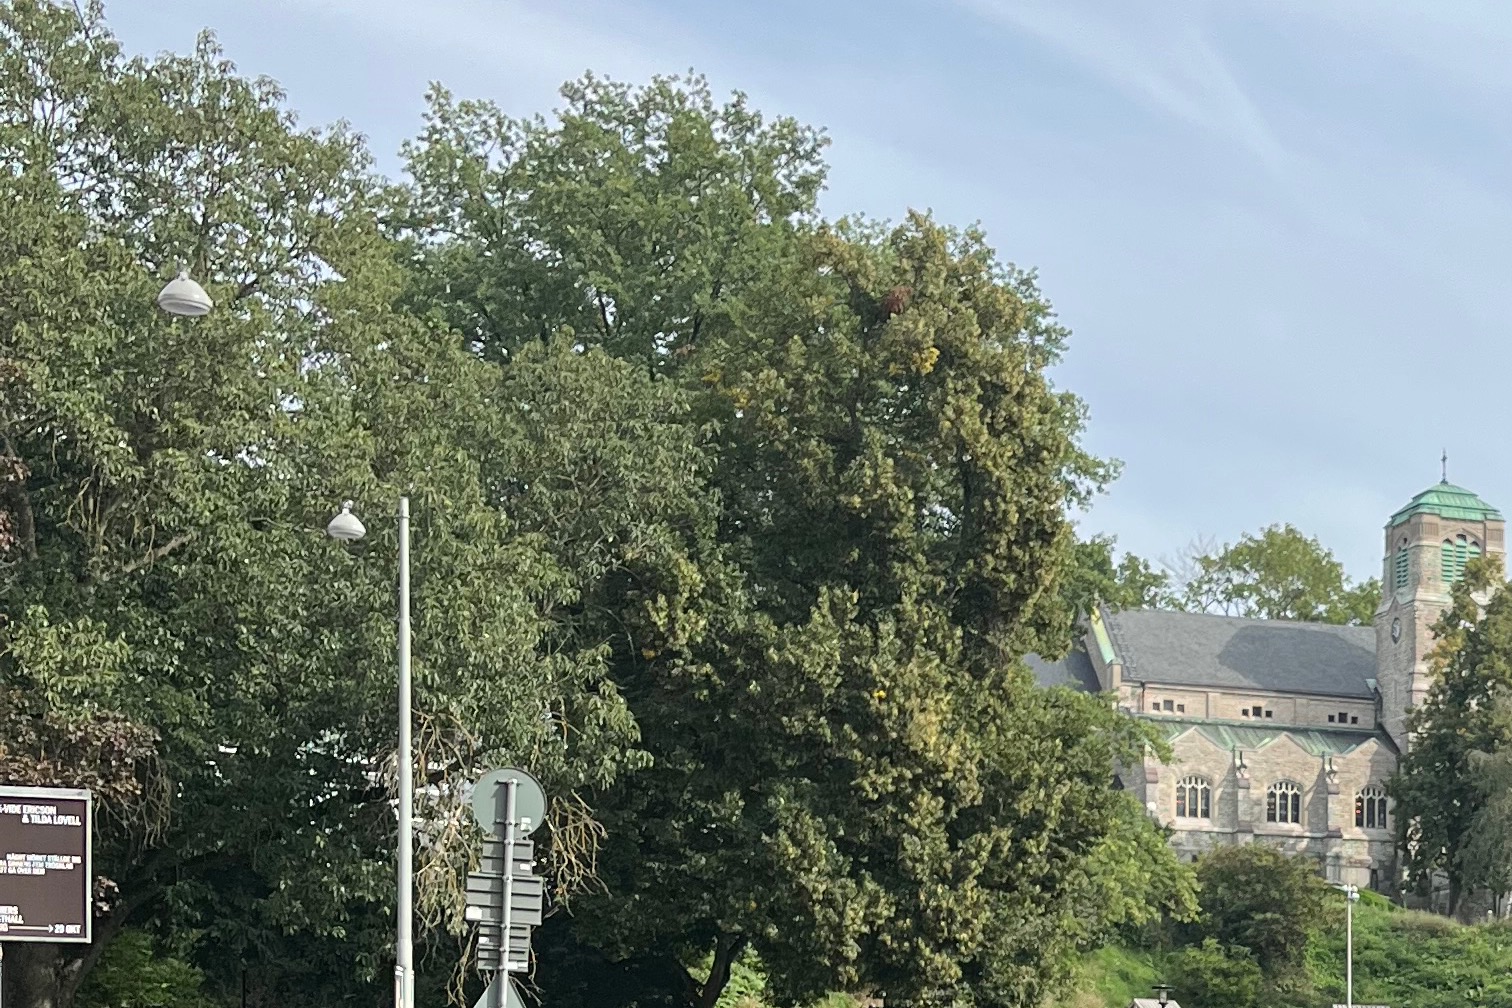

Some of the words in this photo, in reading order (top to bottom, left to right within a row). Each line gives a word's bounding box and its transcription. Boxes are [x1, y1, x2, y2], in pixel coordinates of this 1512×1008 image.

[22, 805, 57, 815] ERICSON
[21, 814, 30, 824] &
[30, 814, 53, 825] TILDA
[53, 815, 82, 826] LOVELL
